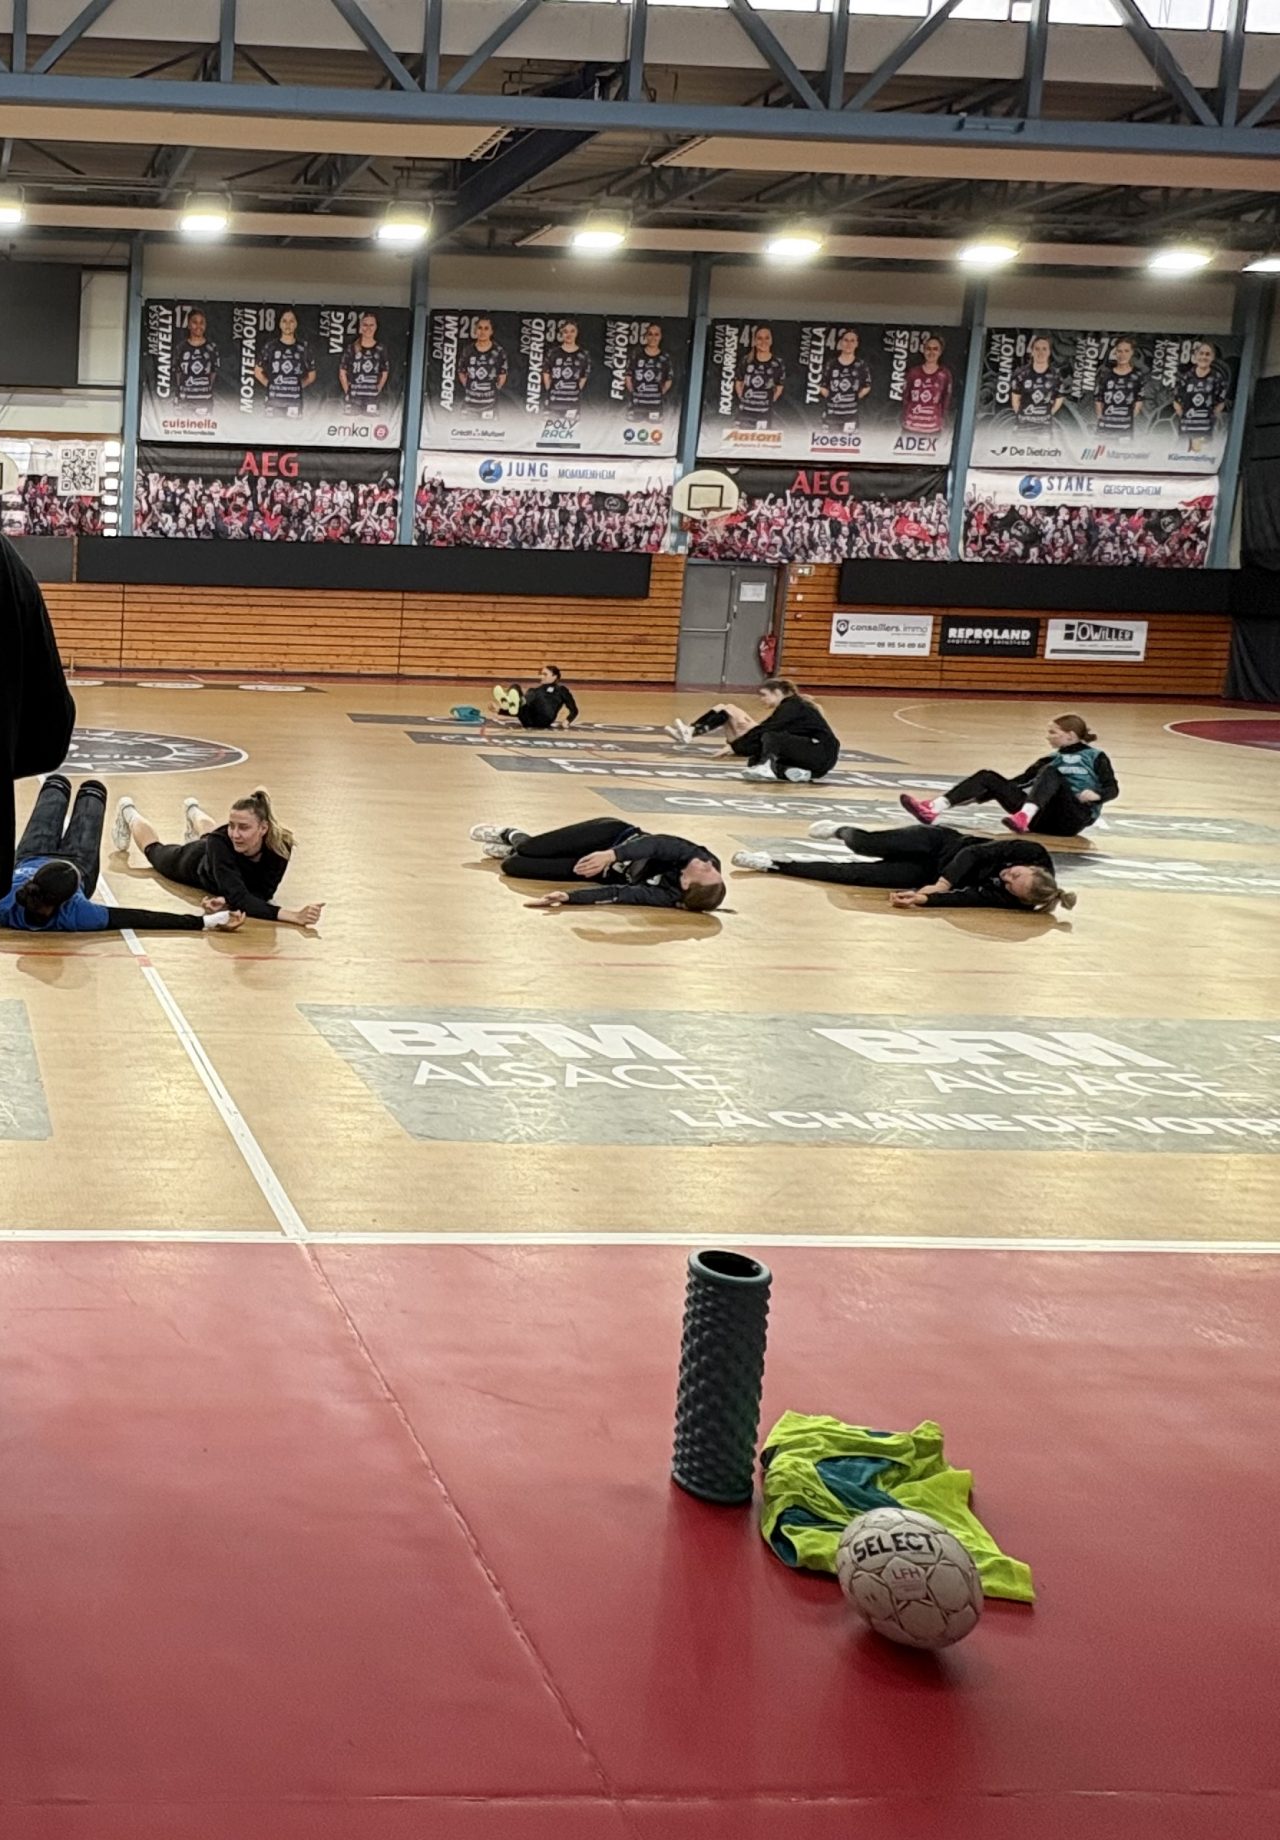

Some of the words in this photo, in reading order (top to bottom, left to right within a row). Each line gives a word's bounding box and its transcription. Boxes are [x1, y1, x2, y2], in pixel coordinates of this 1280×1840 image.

[148, 304, 159, 355] MÉLISSA
[175, 305, 192, 329] 17
[233, 307, 244, 340] YOSR
[258, 308, 276, 332] 18
[320, 310, 330, 338] LISA
[329, 311, 345, 354] VLUG
[157, 305, 173, 398] CHANTELLY
[433, 315, 444, 360] DALILA
[520, 318, 534, 355] NORA
[604, 320, 617, 368] ALBANE
[713, 324, 726, 364] OLIVIA
[799, 327, 813, 365] EMMA
[883, 329, 896, 353] LÉA
[989, 333, 1004, 362] LINA
[240, 308, 257, 413] MOSTEFAOUI
[440, 315, 459, 412] ABDESSELAM
[526, 318, 545, 414] SNEDKERUD
[611, 321, 630, 400] FRACHON
[805, 327, 826, 404] TUCCELLA
[889, 330, 909, 402] FARGUES
[996, 334, 1015, 404] COLINOT
[1071, 337, 1088, 399] MARGAUX
[1082, 337, 1100, 391] IMHOF
[1151, 339, 1169, 380] LYSON
[327, 422, 369, 438] emka
[541, 430, 574, 439] RACK
[545, 420, 577, 430] POLY
[724, 431, 782, 442] Antoni
[810, 433, 861, 447] koesio
[893, 436, 937, 451] ADEX
[1026, 447, 1061, 457] Dietrich
[239, 451, 299, 477] AEG
[507, 461, 549, 478] JUNG
[558, 468, 616, 480] MOMMENHEIM
[791, 470, 851, 496] AEG
[1046, 475, 1094, 492] STANE
[948, 627, 1031, 640] REPROLAND
[350, 1020, 688, 1061] BFM
[810, 1028, 1177, 1068] BFM
[412, 1060, 738, 1091] ALSACE
[924, 1069, 1254, 1098] ALSACE
[669, 1108, 772, 1130] LA
[1014, 1114, 1120, 1135] DE
[1099, 1115, 1280, 1136] VOTR
[853, 1532, 936, 1563] SELECT
[891, 1567, 920, 1581] LFH
